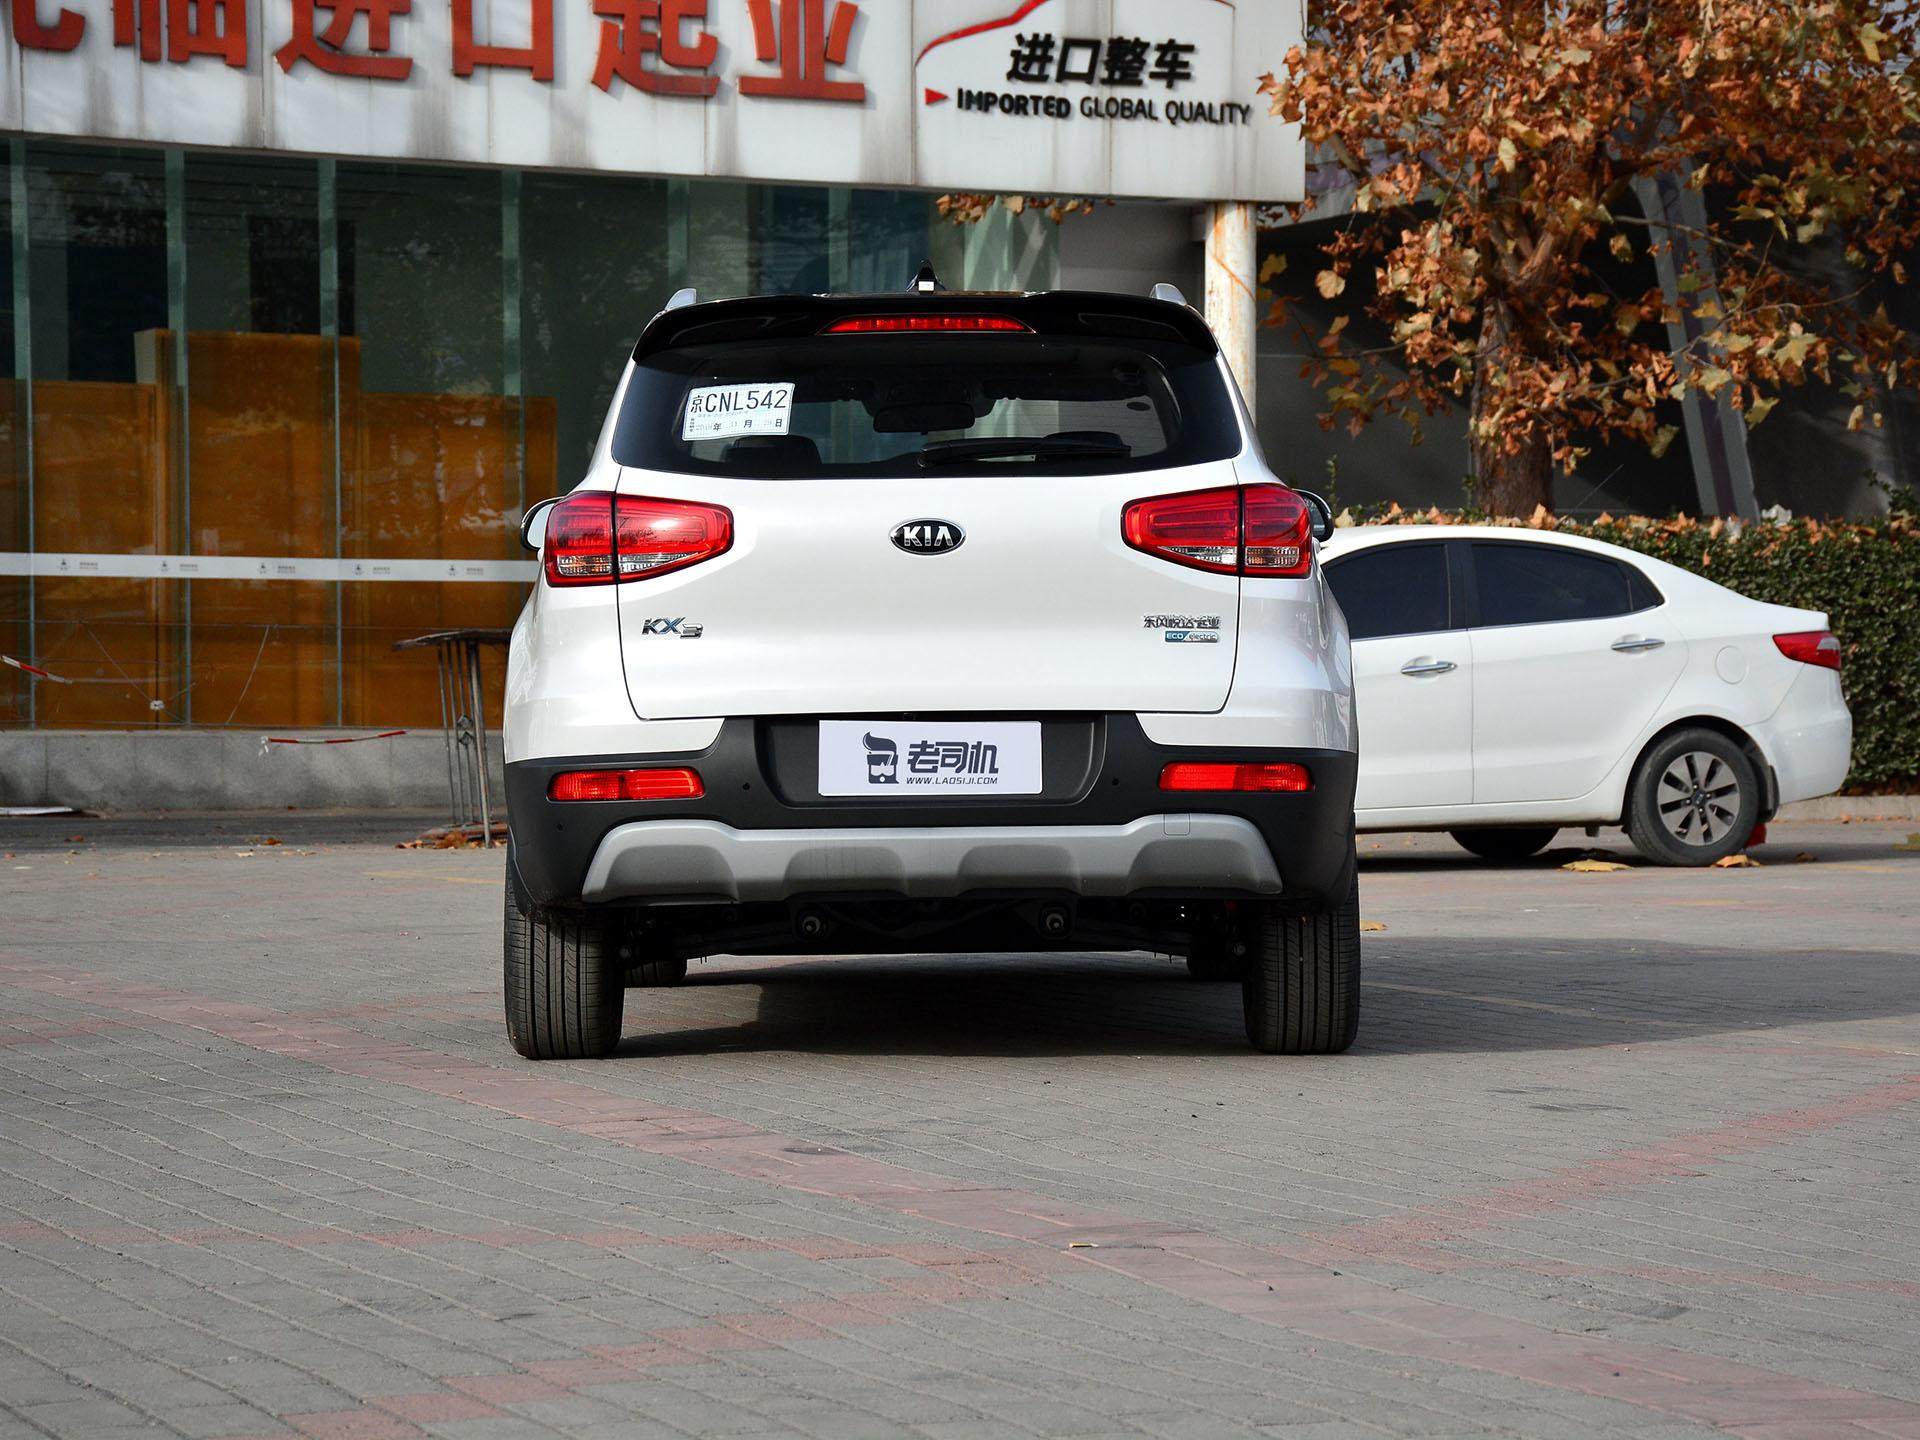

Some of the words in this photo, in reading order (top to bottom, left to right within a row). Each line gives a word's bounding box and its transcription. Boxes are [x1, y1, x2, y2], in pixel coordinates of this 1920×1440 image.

[1006, 33, 1195, 89] 进口整车
[957, 87, 1070, 119] IMPORTED
[1080, 96, 1157, 121] GLOBAL
[1165, 100, 1250, 126] QUALITY
[690, 389, 788, 413] 京CNL542
[903, 525, 953, 547] KIA
[907, 740, 999, 774] 老司机
[906, 776, 998, 785] WWW.LAOSIJI.COM
